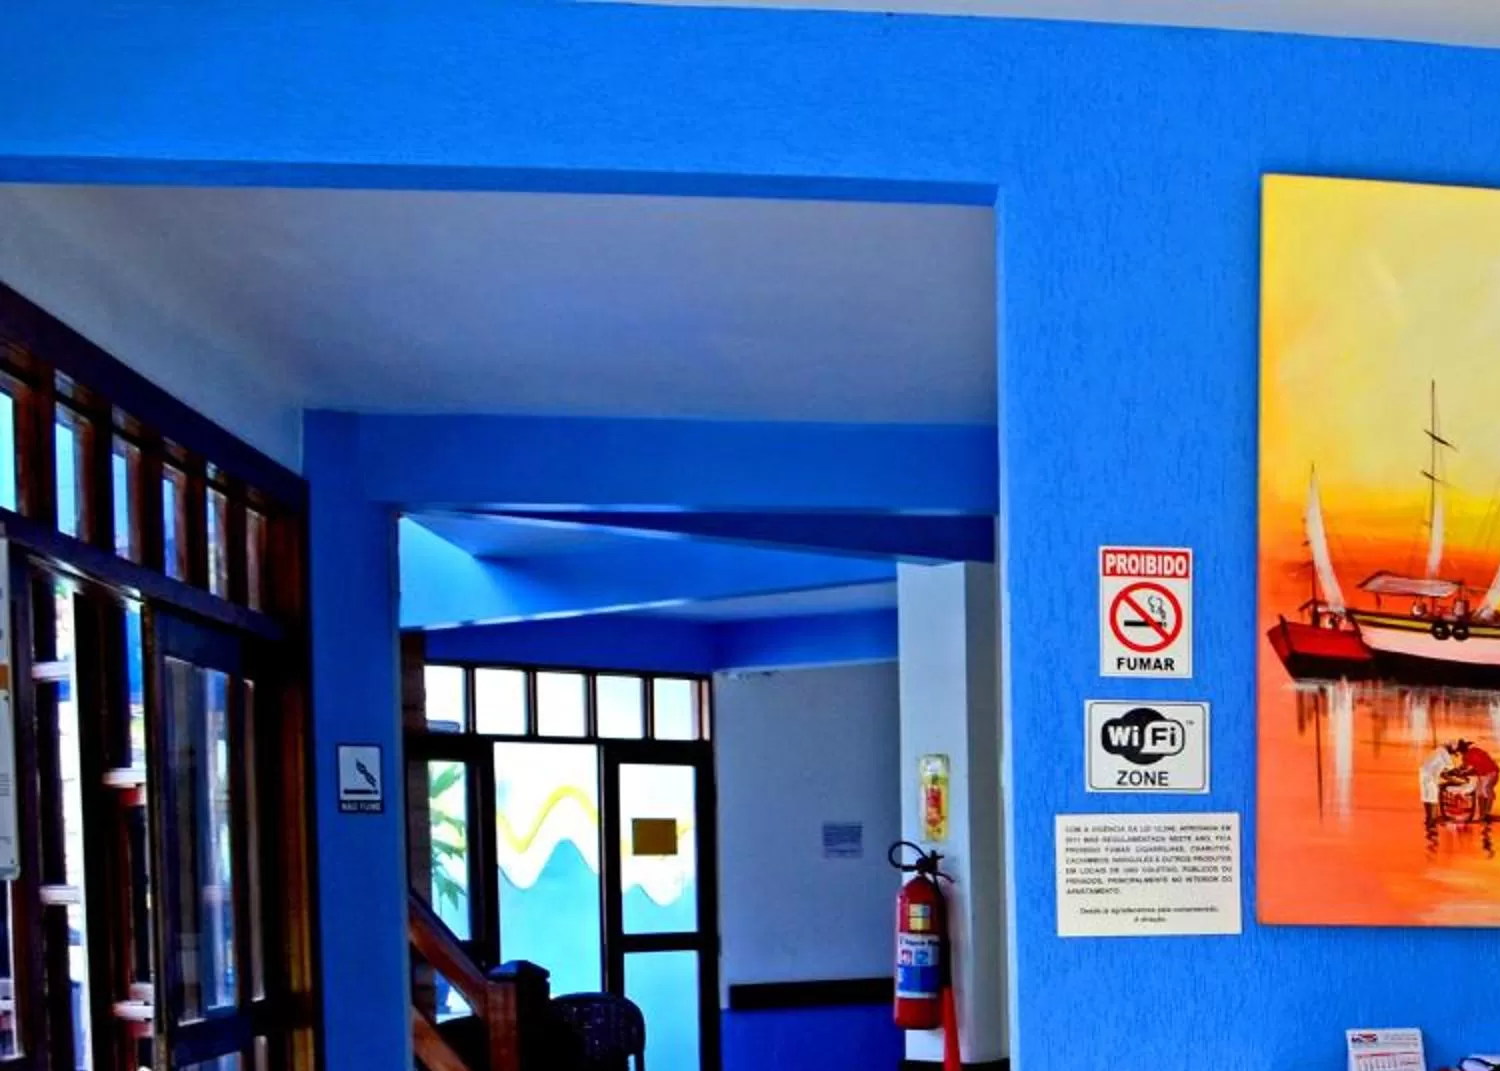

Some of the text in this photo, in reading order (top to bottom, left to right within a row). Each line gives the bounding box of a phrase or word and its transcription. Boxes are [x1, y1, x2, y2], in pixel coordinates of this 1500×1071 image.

[1105, 553, 1188, 577] PROIBIDO
[1116, 656, 1175, 671] FUMAR
[1116, 770, 1169, 787] ZONE
